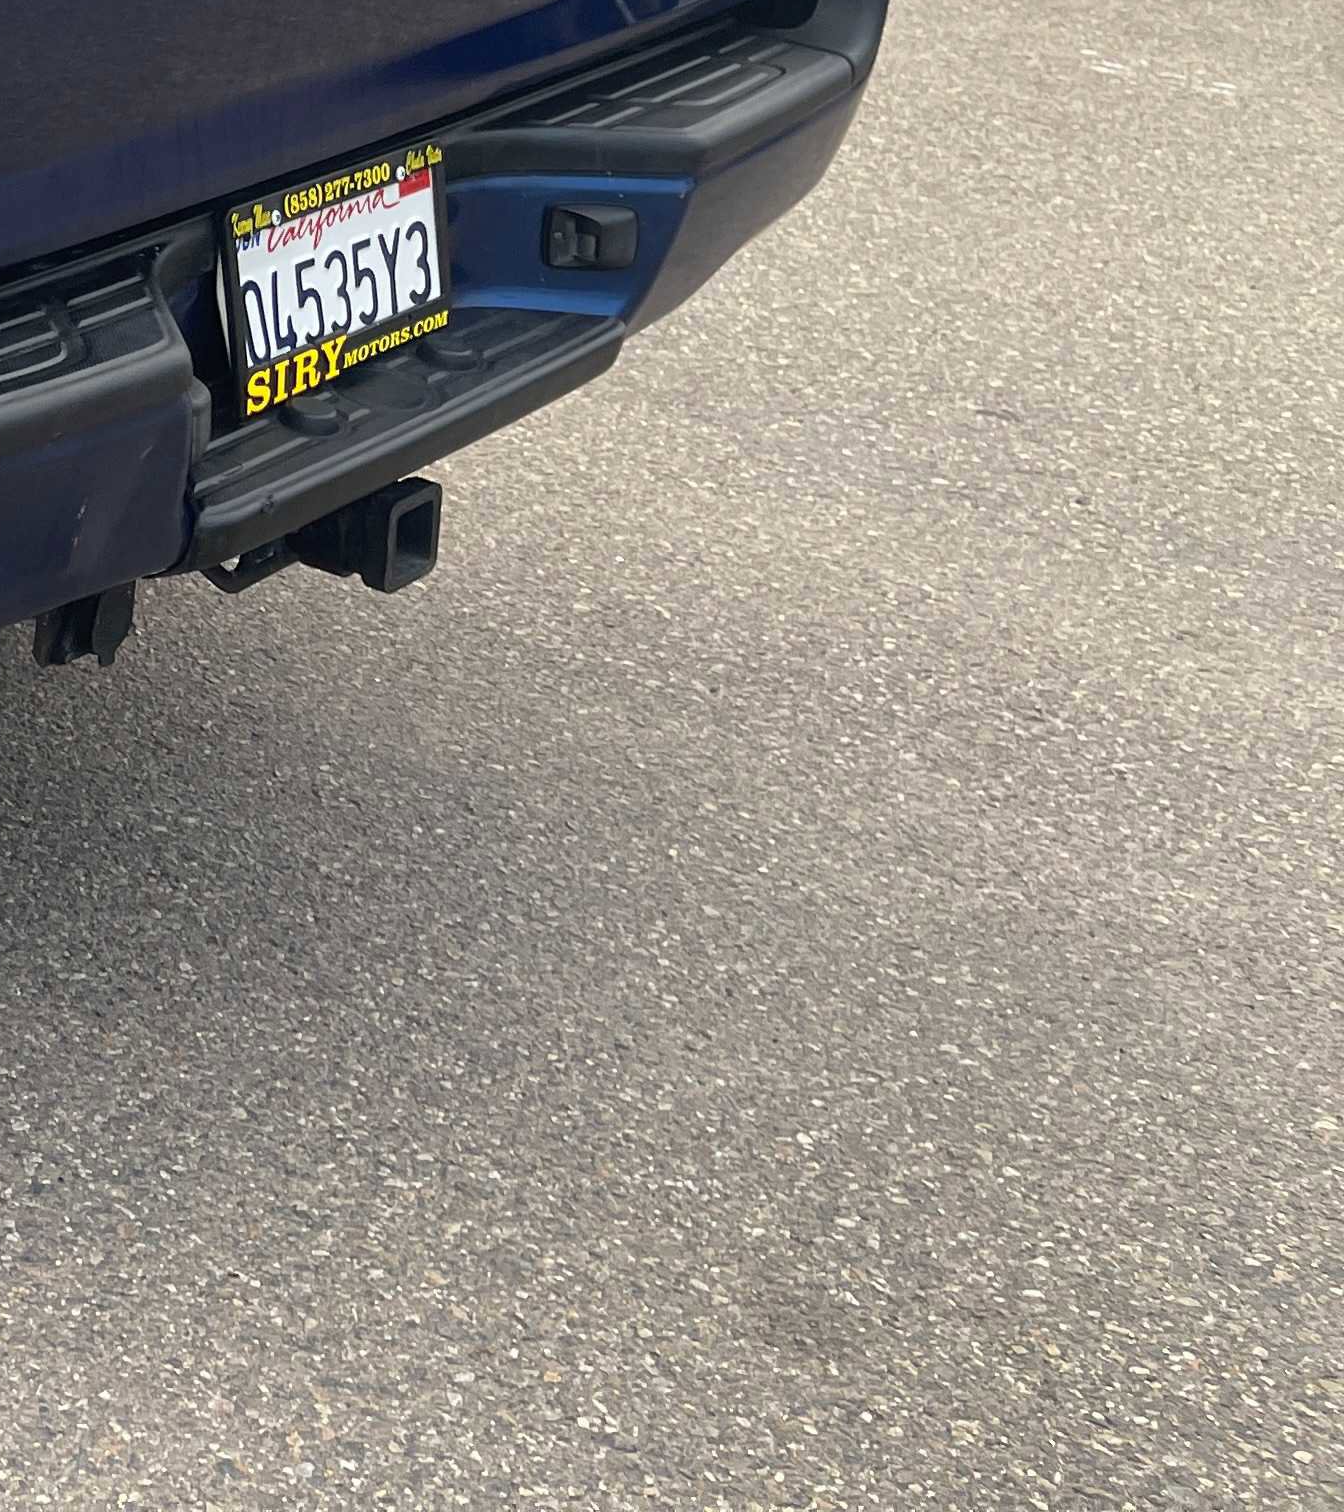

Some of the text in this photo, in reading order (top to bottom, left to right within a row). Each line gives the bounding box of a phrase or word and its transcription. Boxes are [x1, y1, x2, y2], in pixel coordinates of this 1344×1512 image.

[267, 188, 400, 253] California
[284, 183, 322, 218] (858)
[325, 163, 391, 202] 277-7300
[247, 311, 449, 416] SIRY MOTORS.COM
